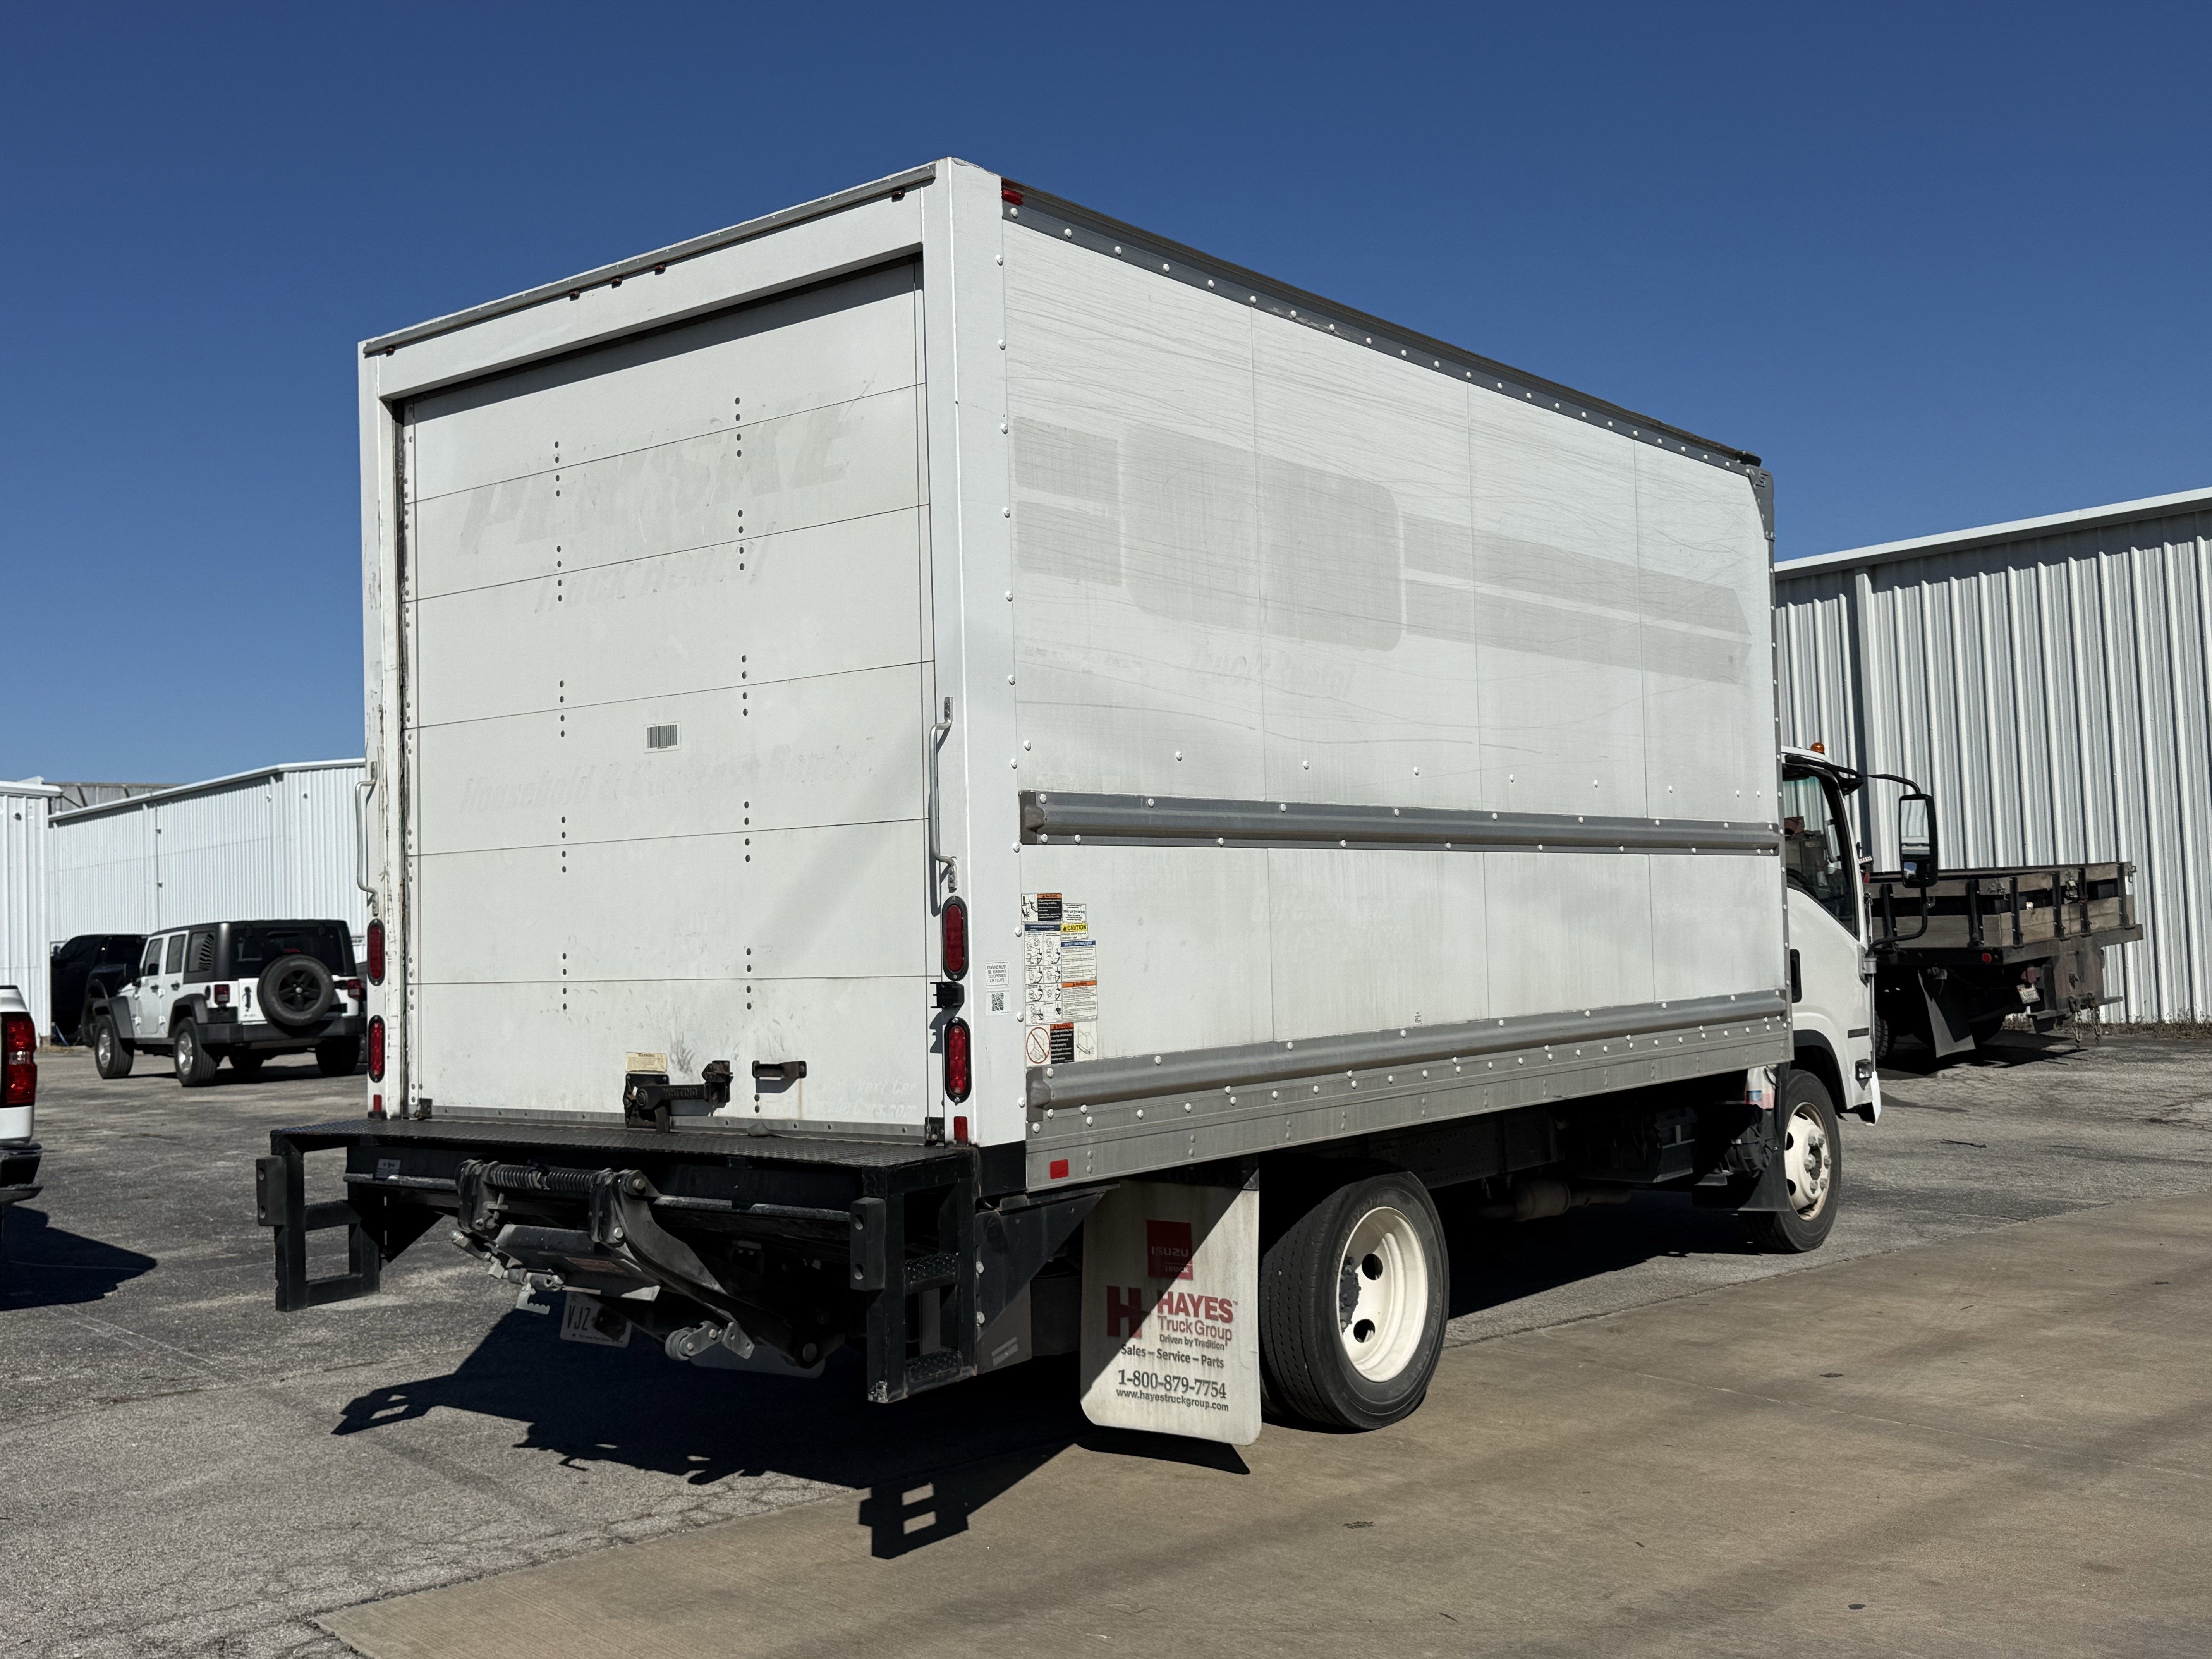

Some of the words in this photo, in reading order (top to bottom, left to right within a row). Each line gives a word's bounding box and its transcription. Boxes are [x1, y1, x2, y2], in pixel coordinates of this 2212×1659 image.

[1151, 1246, 1189, 1257] ISUZU
[1164, 1265, 1189, 1274] TRUCK
[1156, 1290, 1233, 1324] HAYES
[1157, 1315, 1193, 1334] Truck
[1195, 1319, 1232, 1346] Group
[1159, 1334, 1183, 1345] Driven
[1184, 1336, 1194, 1347] by
[1194, 1338, 1224, 1351] Tradition
[1121, 1344, 1146, 1357] Sales
[1156, 1348, 1190, 1363] Service
[1201, 1354, 1224, 1369] Parts
[1118, 1369, 1227, 1399] 1-800-879-7754
[1116, 1389, 1229, 1412] www.hayestruckgroup.com
